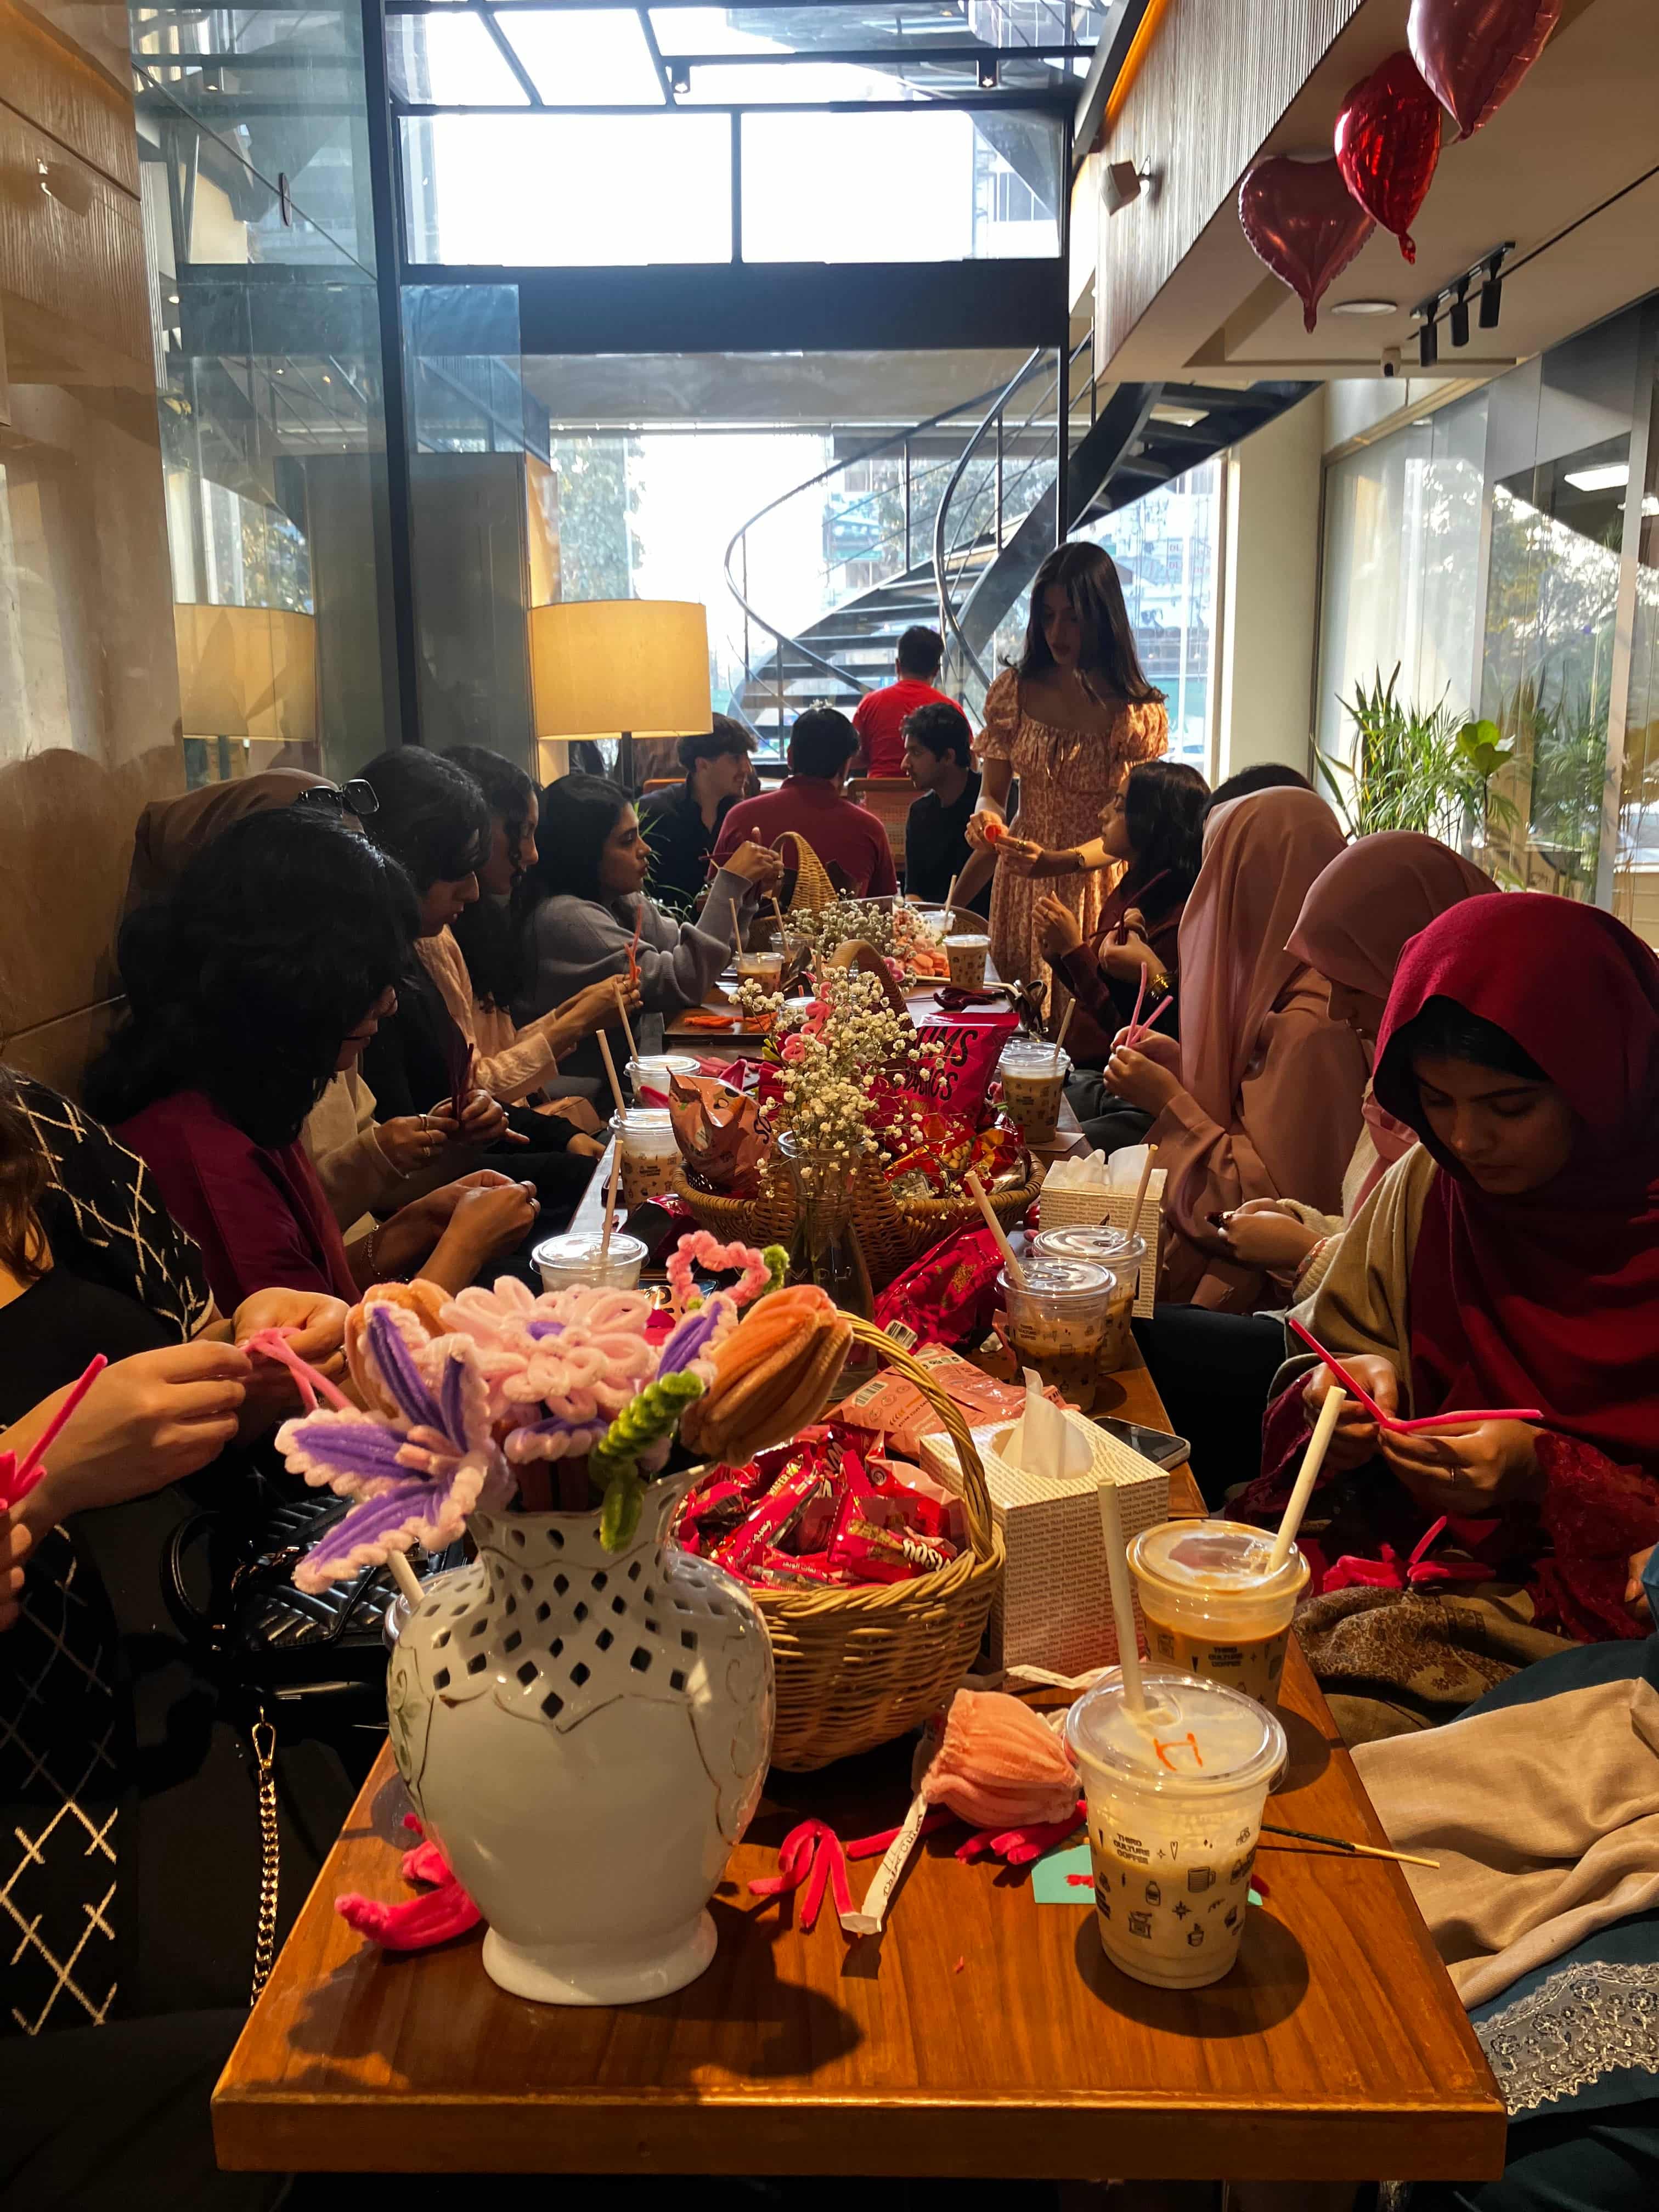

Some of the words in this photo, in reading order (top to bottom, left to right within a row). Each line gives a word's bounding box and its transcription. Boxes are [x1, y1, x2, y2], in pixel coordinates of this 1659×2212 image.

[1116, 1833, 1142, 1846] THIRD
[1113, 1839, 1150, 1857] CULTURE
[1117, 1849, 1149, 1865] COFFEE
